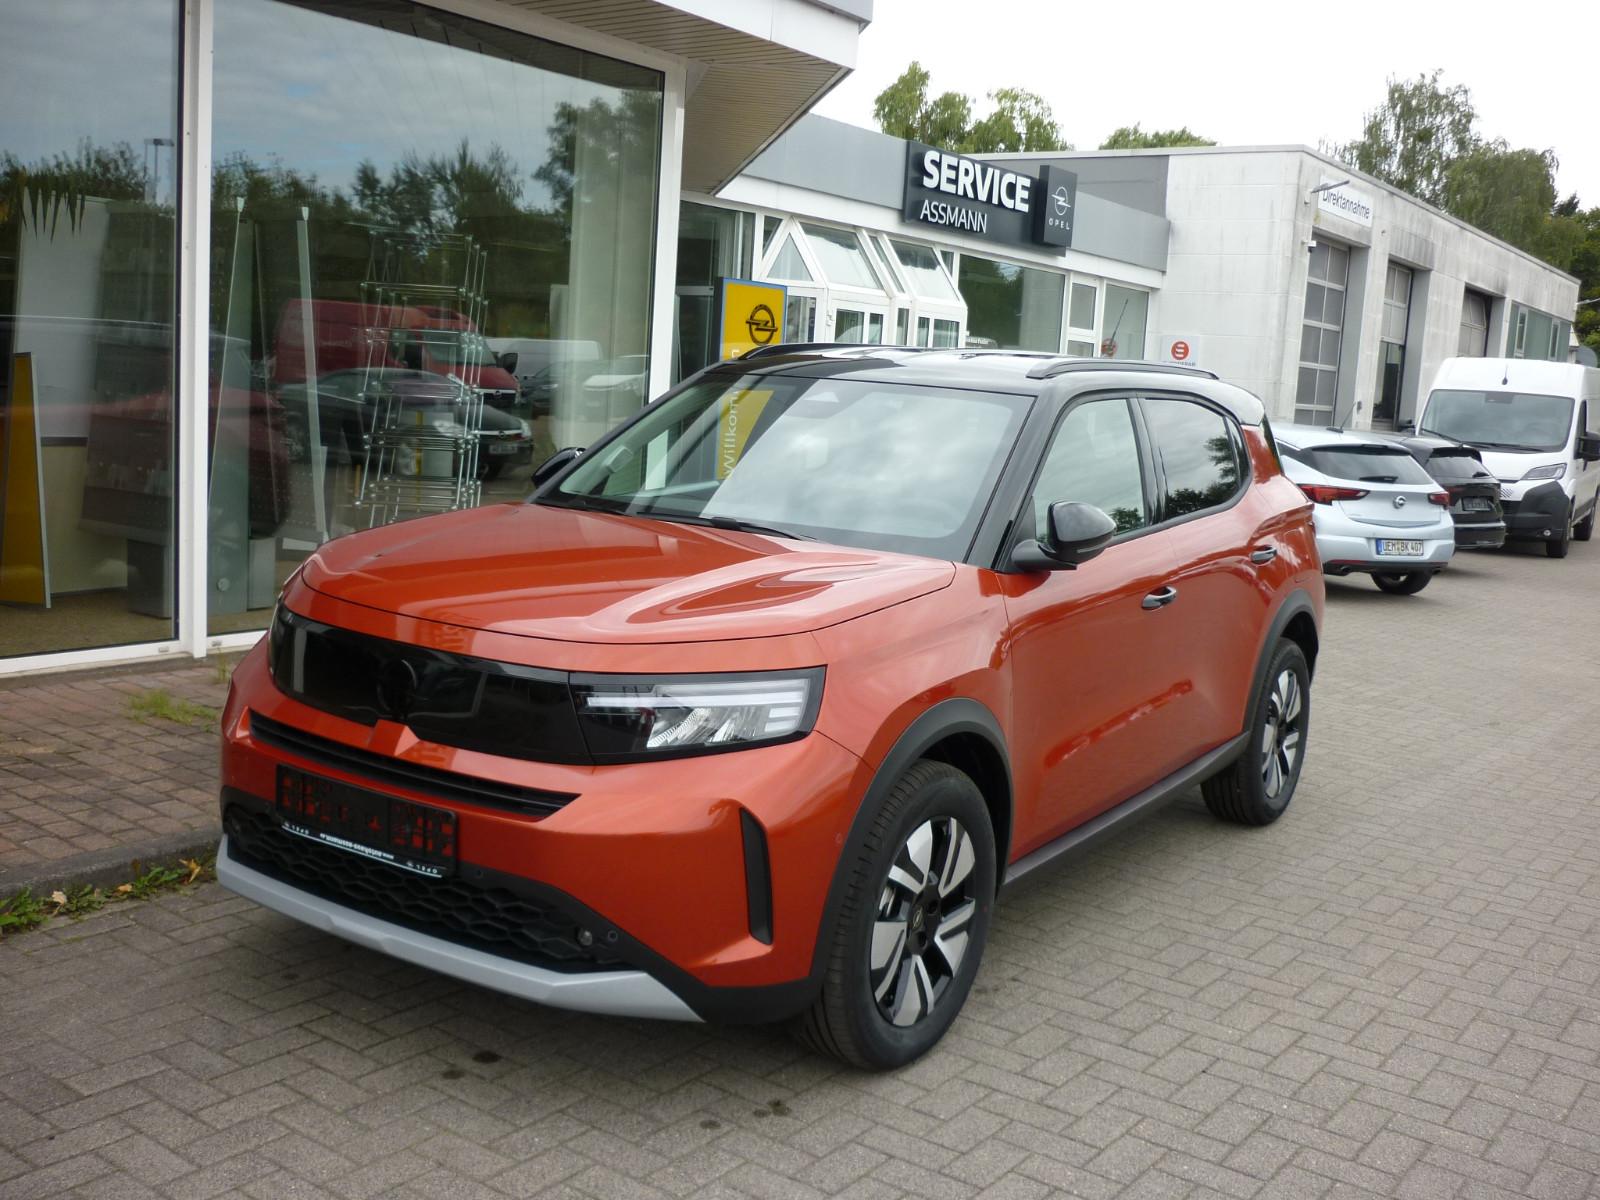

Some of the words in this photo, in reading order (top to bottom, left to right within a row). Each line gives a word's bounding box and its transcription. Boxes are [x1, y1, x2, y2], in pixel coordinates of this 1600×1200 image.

[922, 150, 1031, 213] SERVICE
[919, 199, 988, 234] ASSMANN
[1322, 188, 1370, 220] Direktannahme
[1048, 217, 1070, 231] OPEL
